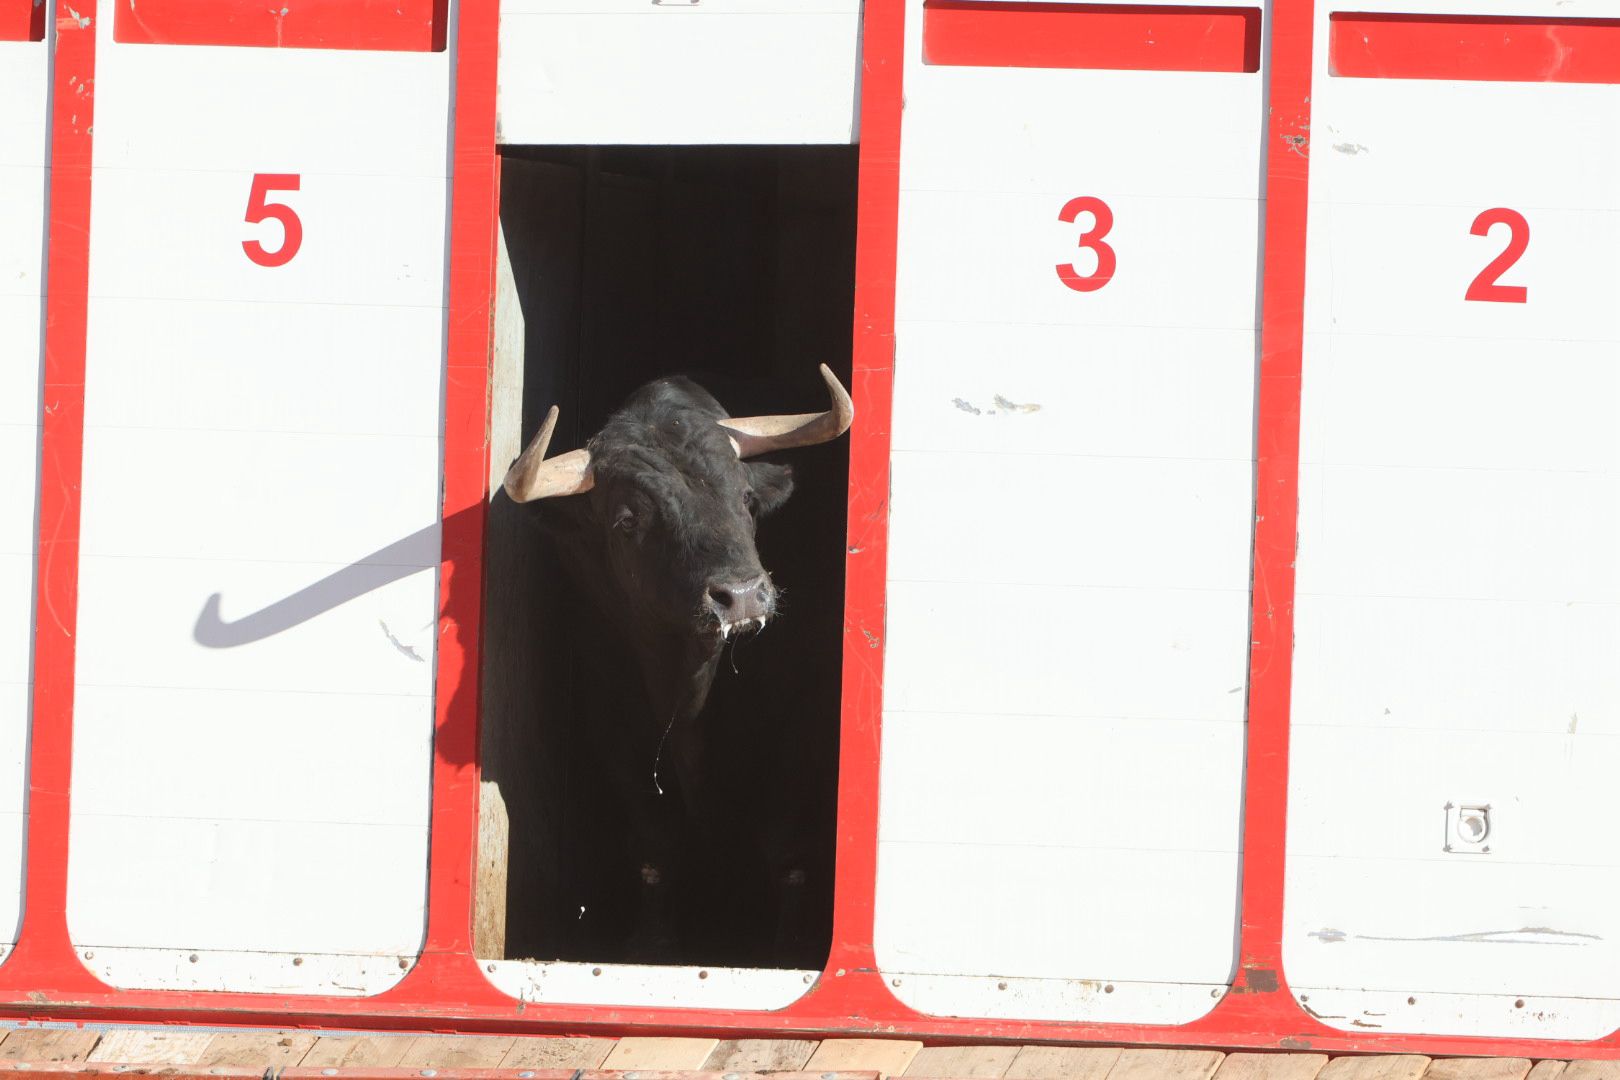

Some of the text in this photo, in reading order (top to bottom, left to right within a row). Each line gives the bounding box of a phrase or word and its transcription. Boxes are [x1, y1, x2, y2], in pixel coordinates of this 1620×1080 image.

[241, 173, 303, 267] 5
[1056, 196, 1117, 292] 3
[1465, 208, 1530, 303] 2
